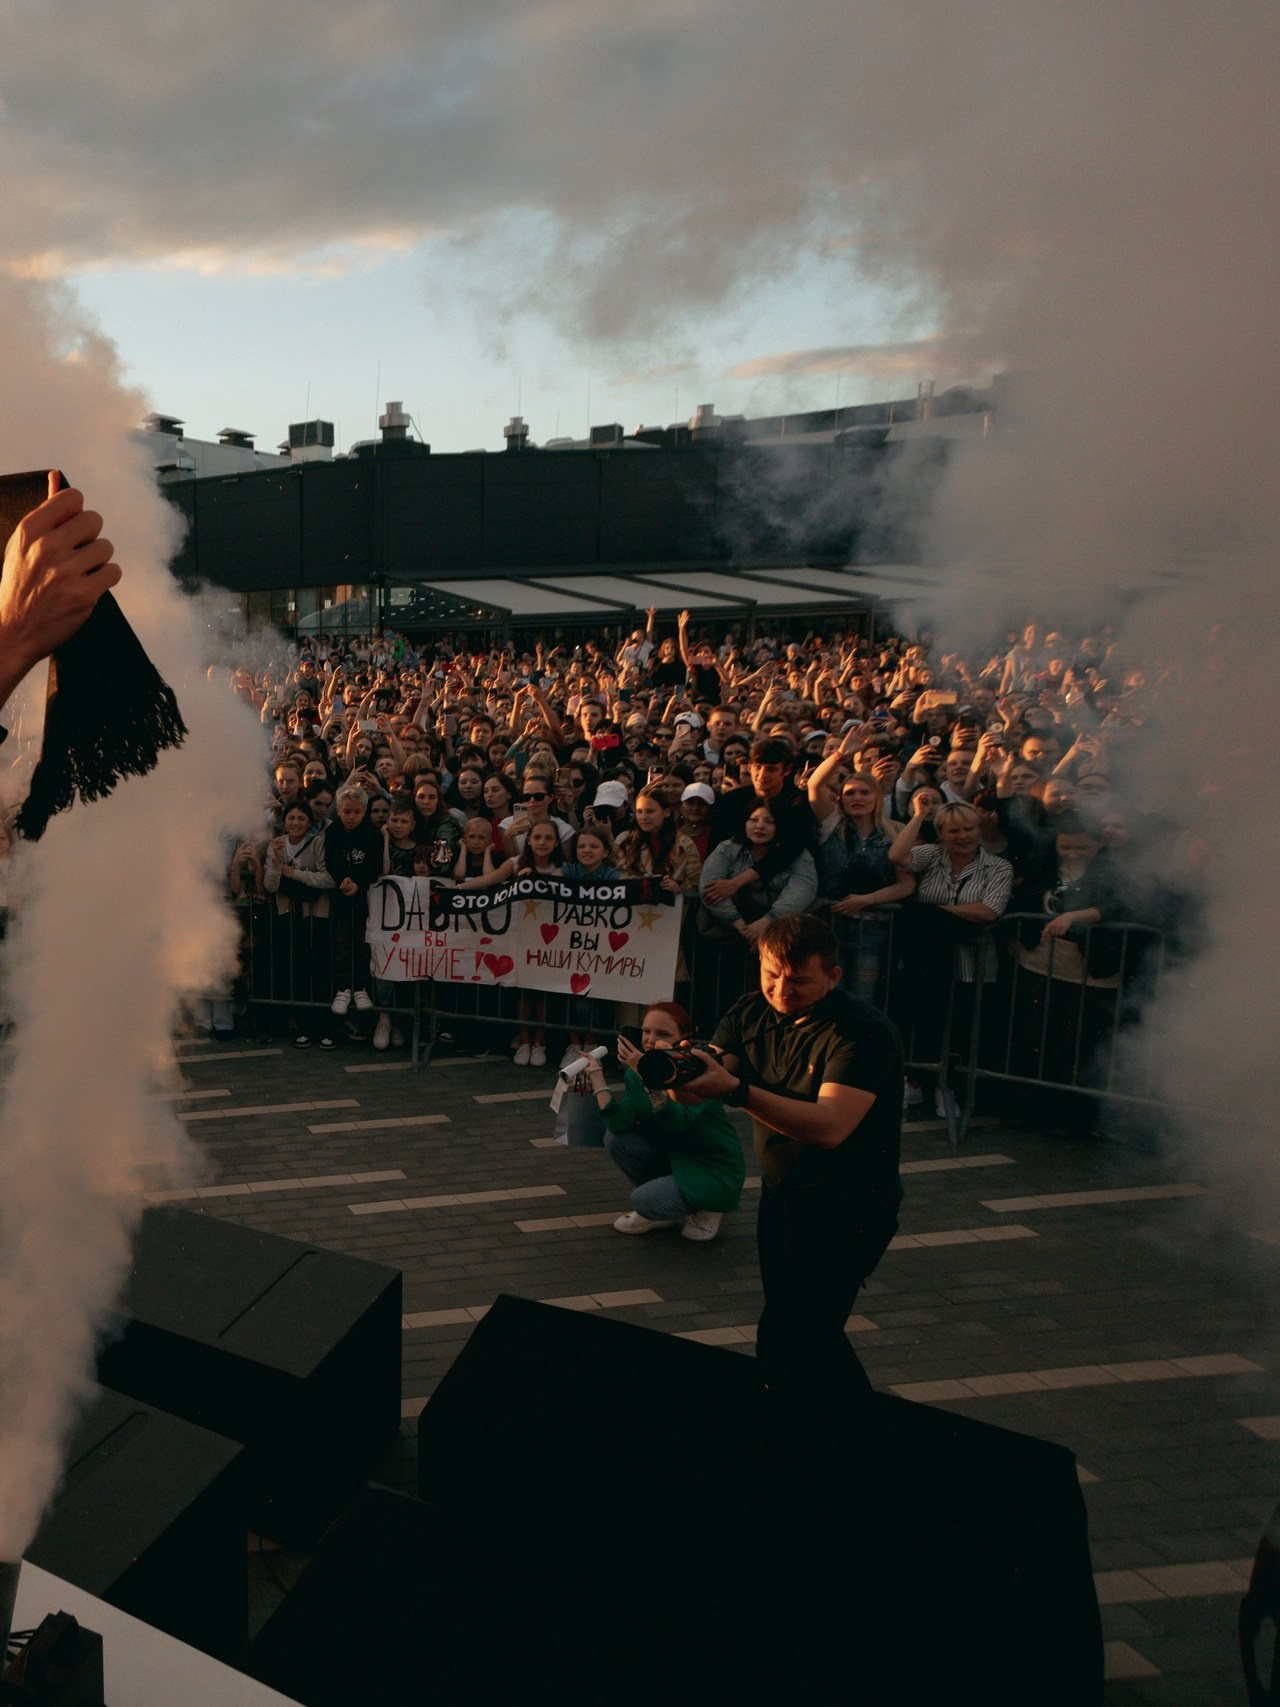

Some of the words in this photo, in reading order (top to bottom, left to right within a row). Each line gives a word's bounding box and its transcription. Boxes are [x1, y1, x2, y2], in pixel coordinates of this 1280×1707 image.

[451, 894, 489, 909] ЭТО
[493, 878, 572, 905] ЮНОСТЬ
[579, 884, 626, 901] МОЯ
[424, 930, 447, 947] ВЫ
[570, 930, 599, 951] ВЫ
[526, 949, 572, 970] НАШИ
[576, 951, 646, 978] КУМИРЫ
